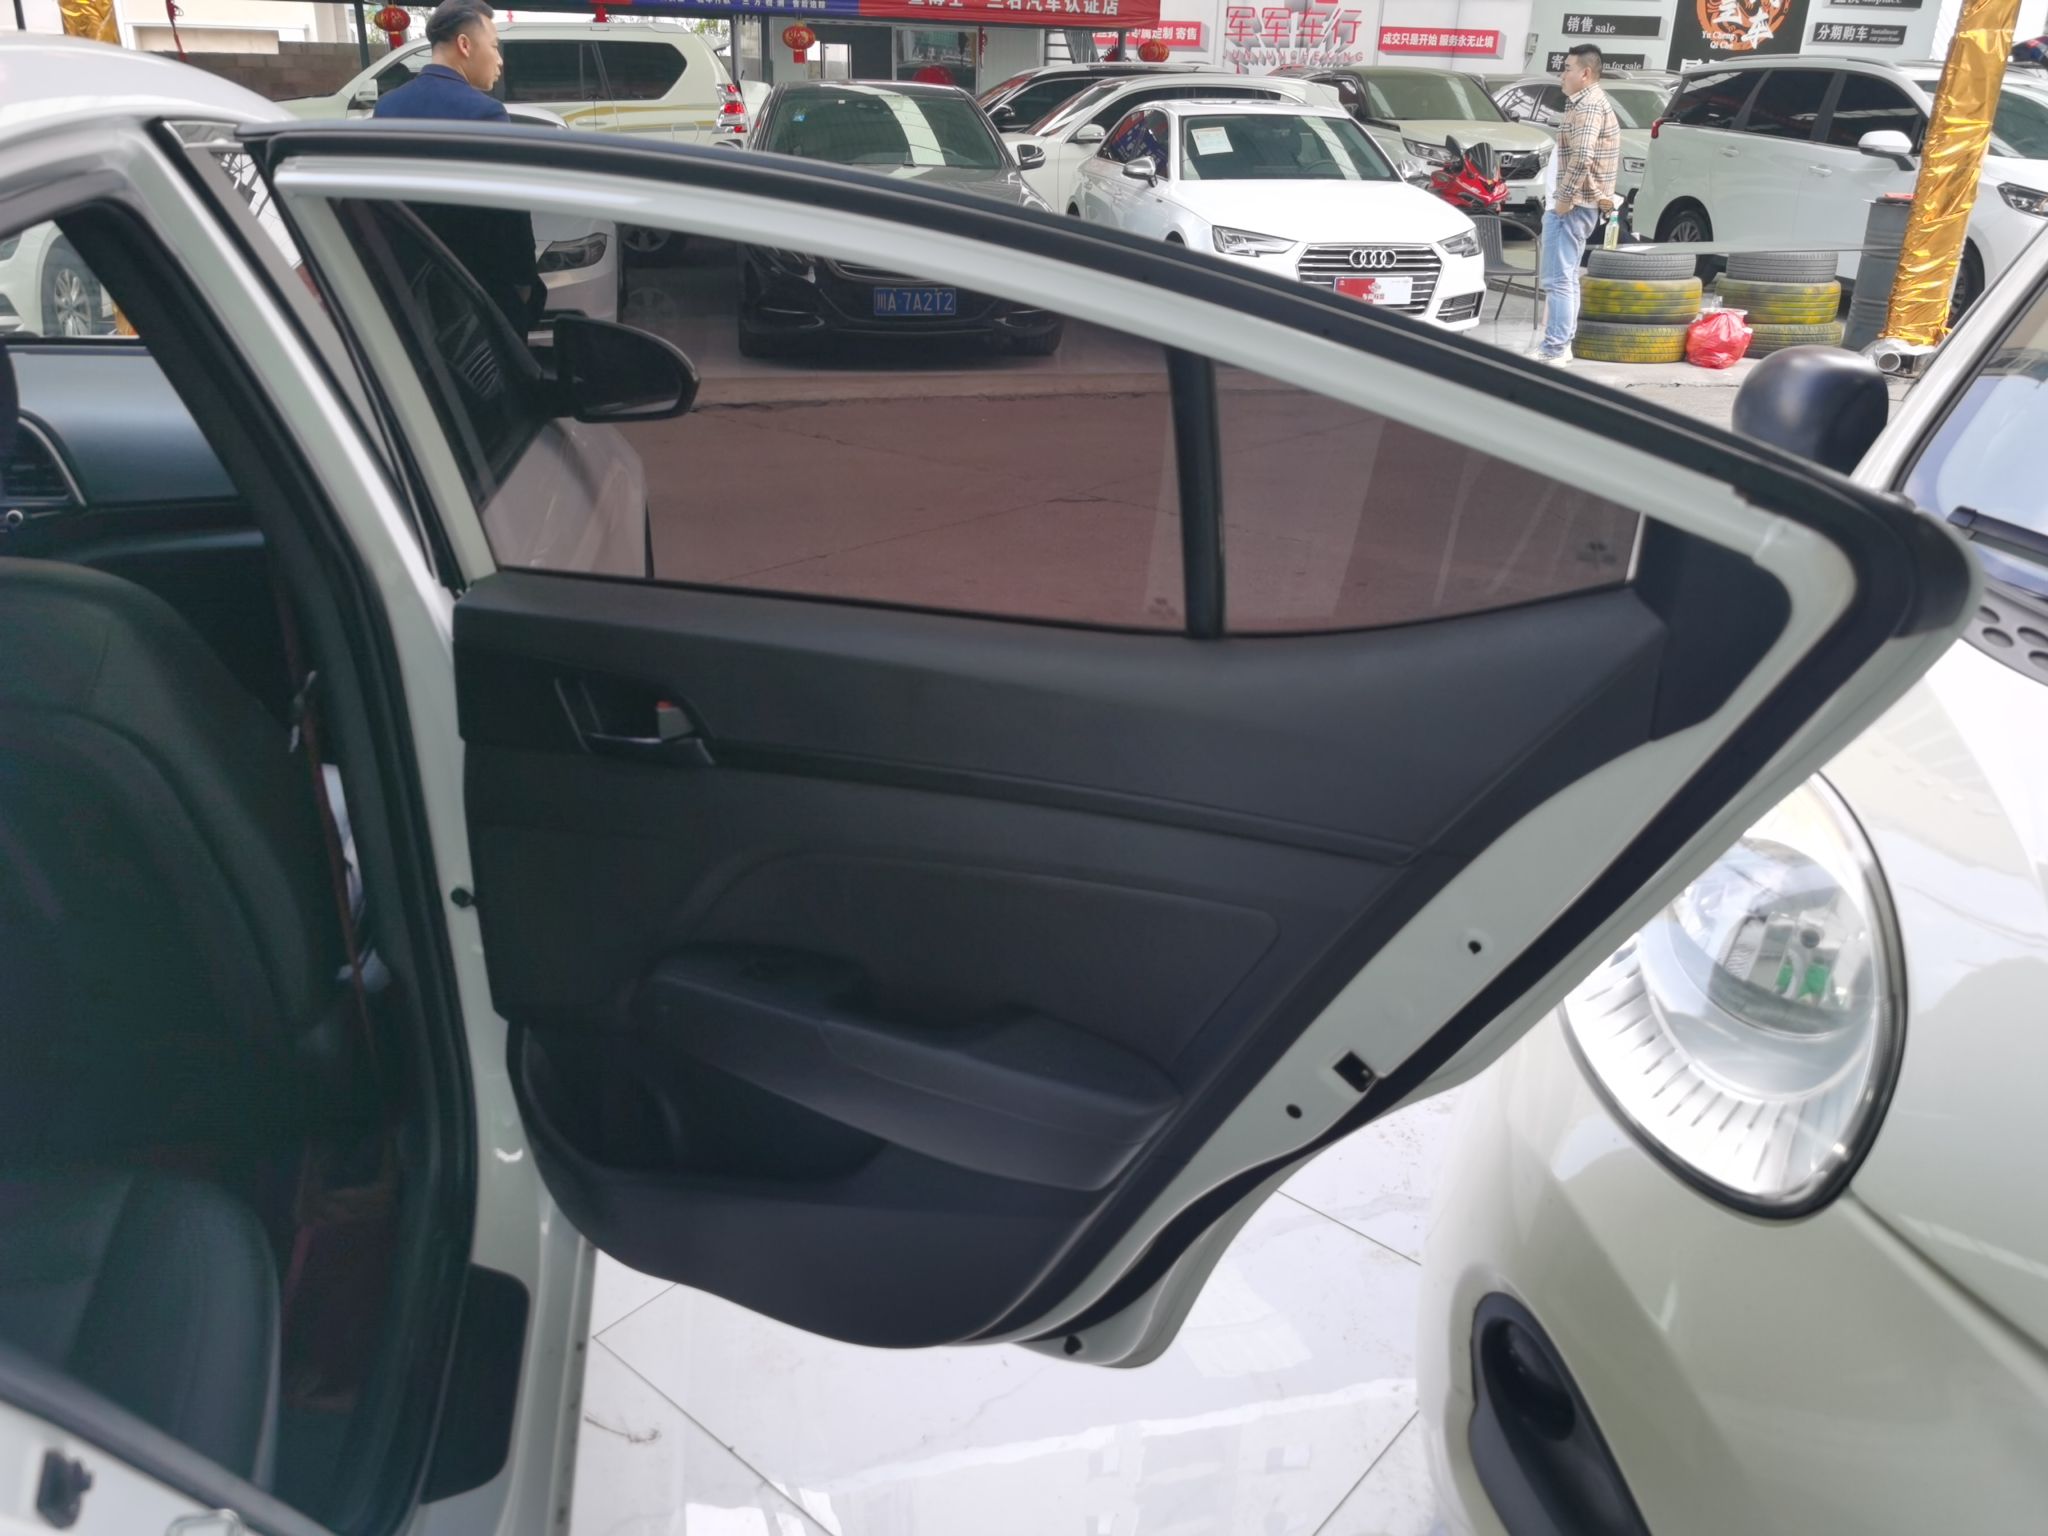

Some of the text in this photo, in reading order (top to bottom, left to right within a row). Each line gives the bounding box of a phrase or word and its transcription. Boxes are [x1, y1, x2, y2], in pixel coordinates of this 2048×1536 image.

[1224, 6, 1362, 44] 军军车行
[1566, 16, 1594, 32] 销售
[1594, 23, 1616, 33] sale
[1175, 27, 1197, 41] 寄售
[1817, 24, 1869, 41] 分期购车
[1382, 33, 1494, 48] 成交只是开始 服务永无止境
[1624, 62, 1642, 70] sale
